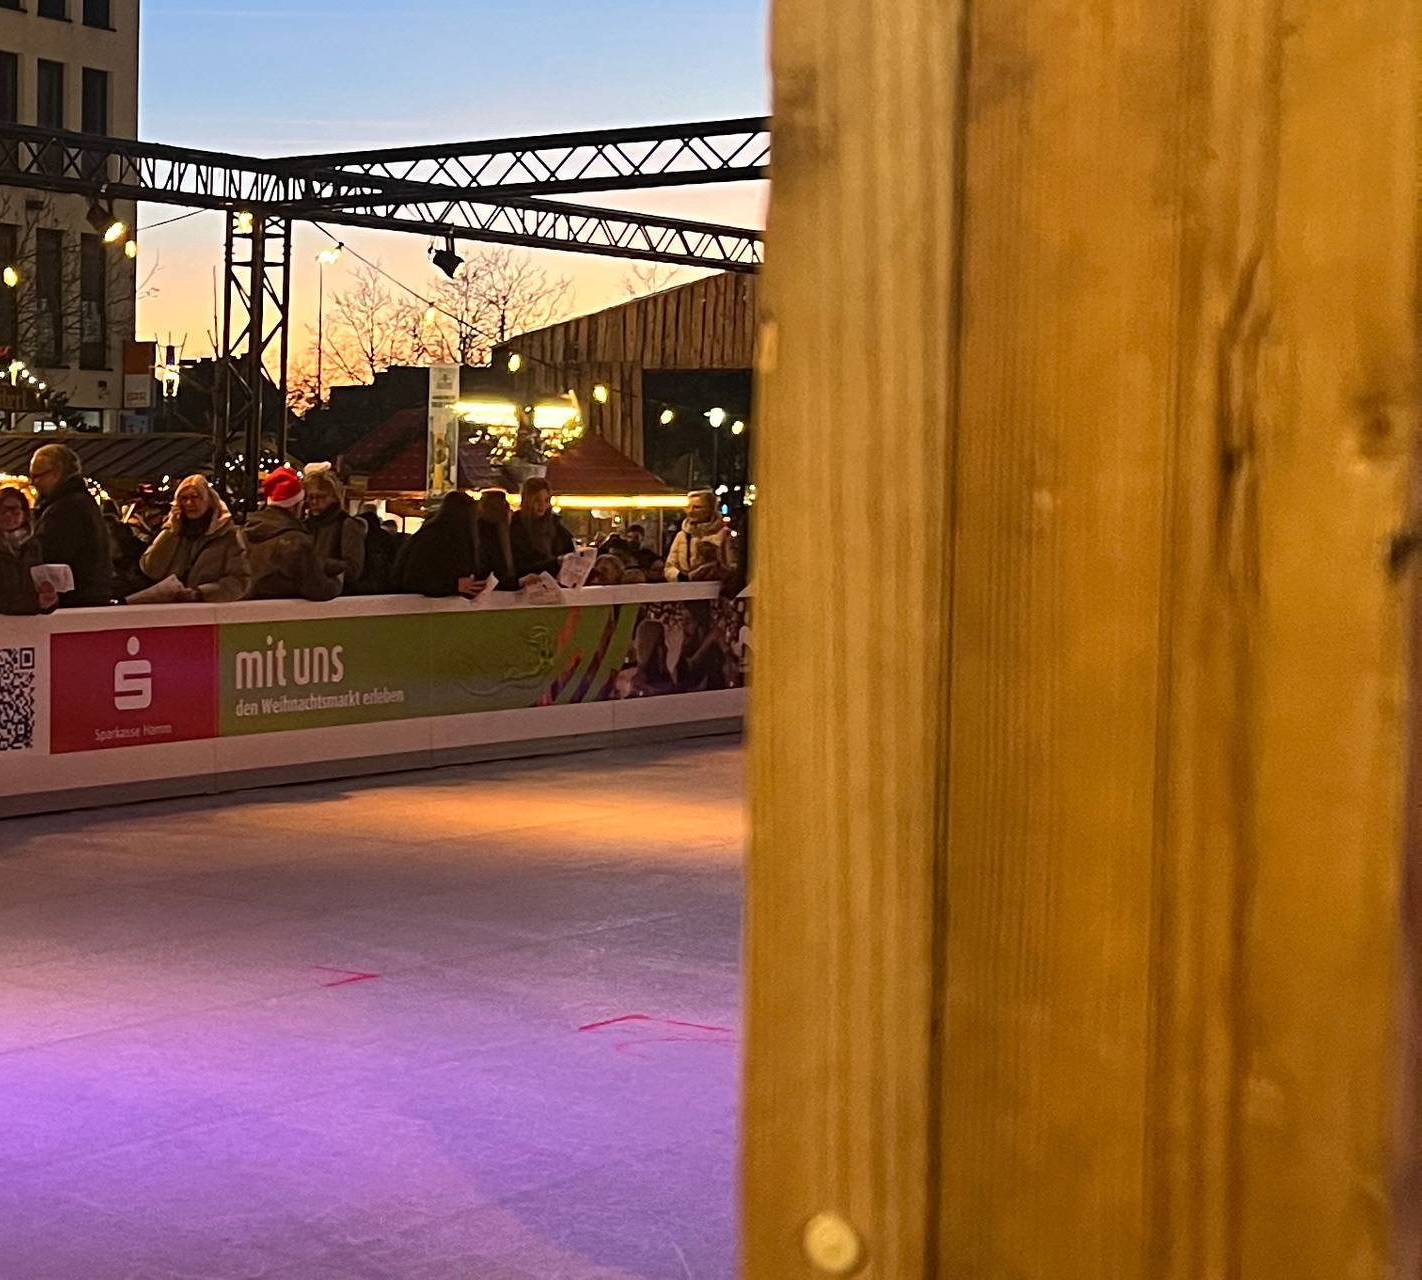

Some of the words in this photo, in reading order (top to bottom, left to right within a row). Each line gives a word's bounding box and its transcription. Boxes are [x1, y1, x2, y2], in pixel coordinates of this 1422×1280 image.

[236, 635, 287, 689] mit
[293, 645, 345, 686] uns
[236, 700, 258, 717] den
[262, 689, 361, 714] Weihnachtsmarkt
[363, 686, 404, 706] erleben
[94, 726, 140, 742] Sparkasse
[143, 724, 172, 736] Hamm
